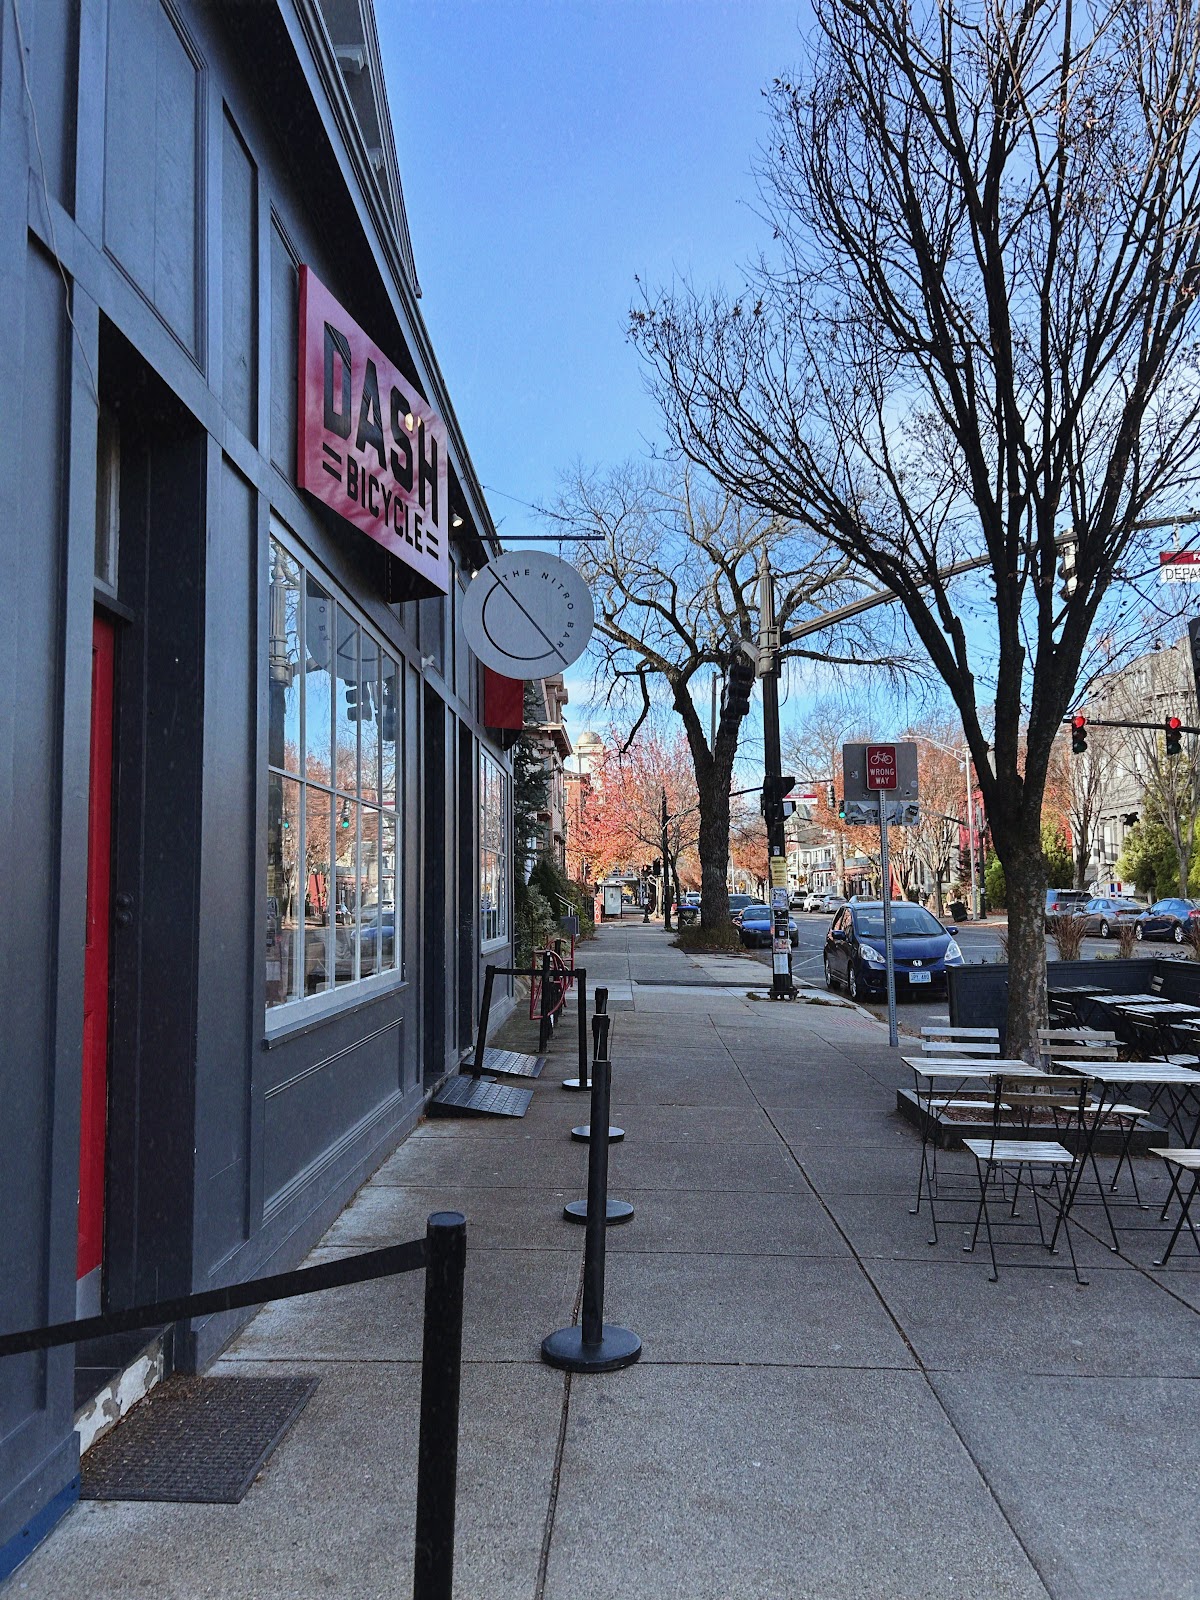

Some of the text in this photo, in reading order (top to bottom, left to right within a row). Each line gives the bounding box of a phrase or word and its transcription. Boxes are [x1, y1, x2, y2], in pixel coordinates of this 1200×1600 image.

[324, 320, 439, 529] DASH
[347, 454, 423, 554] BICYCLE
[502, 568, 574, 648] THE NITRO BAR
[869, 768, 895, 776] WRONG
[875, 777, 890, 785] WAY
